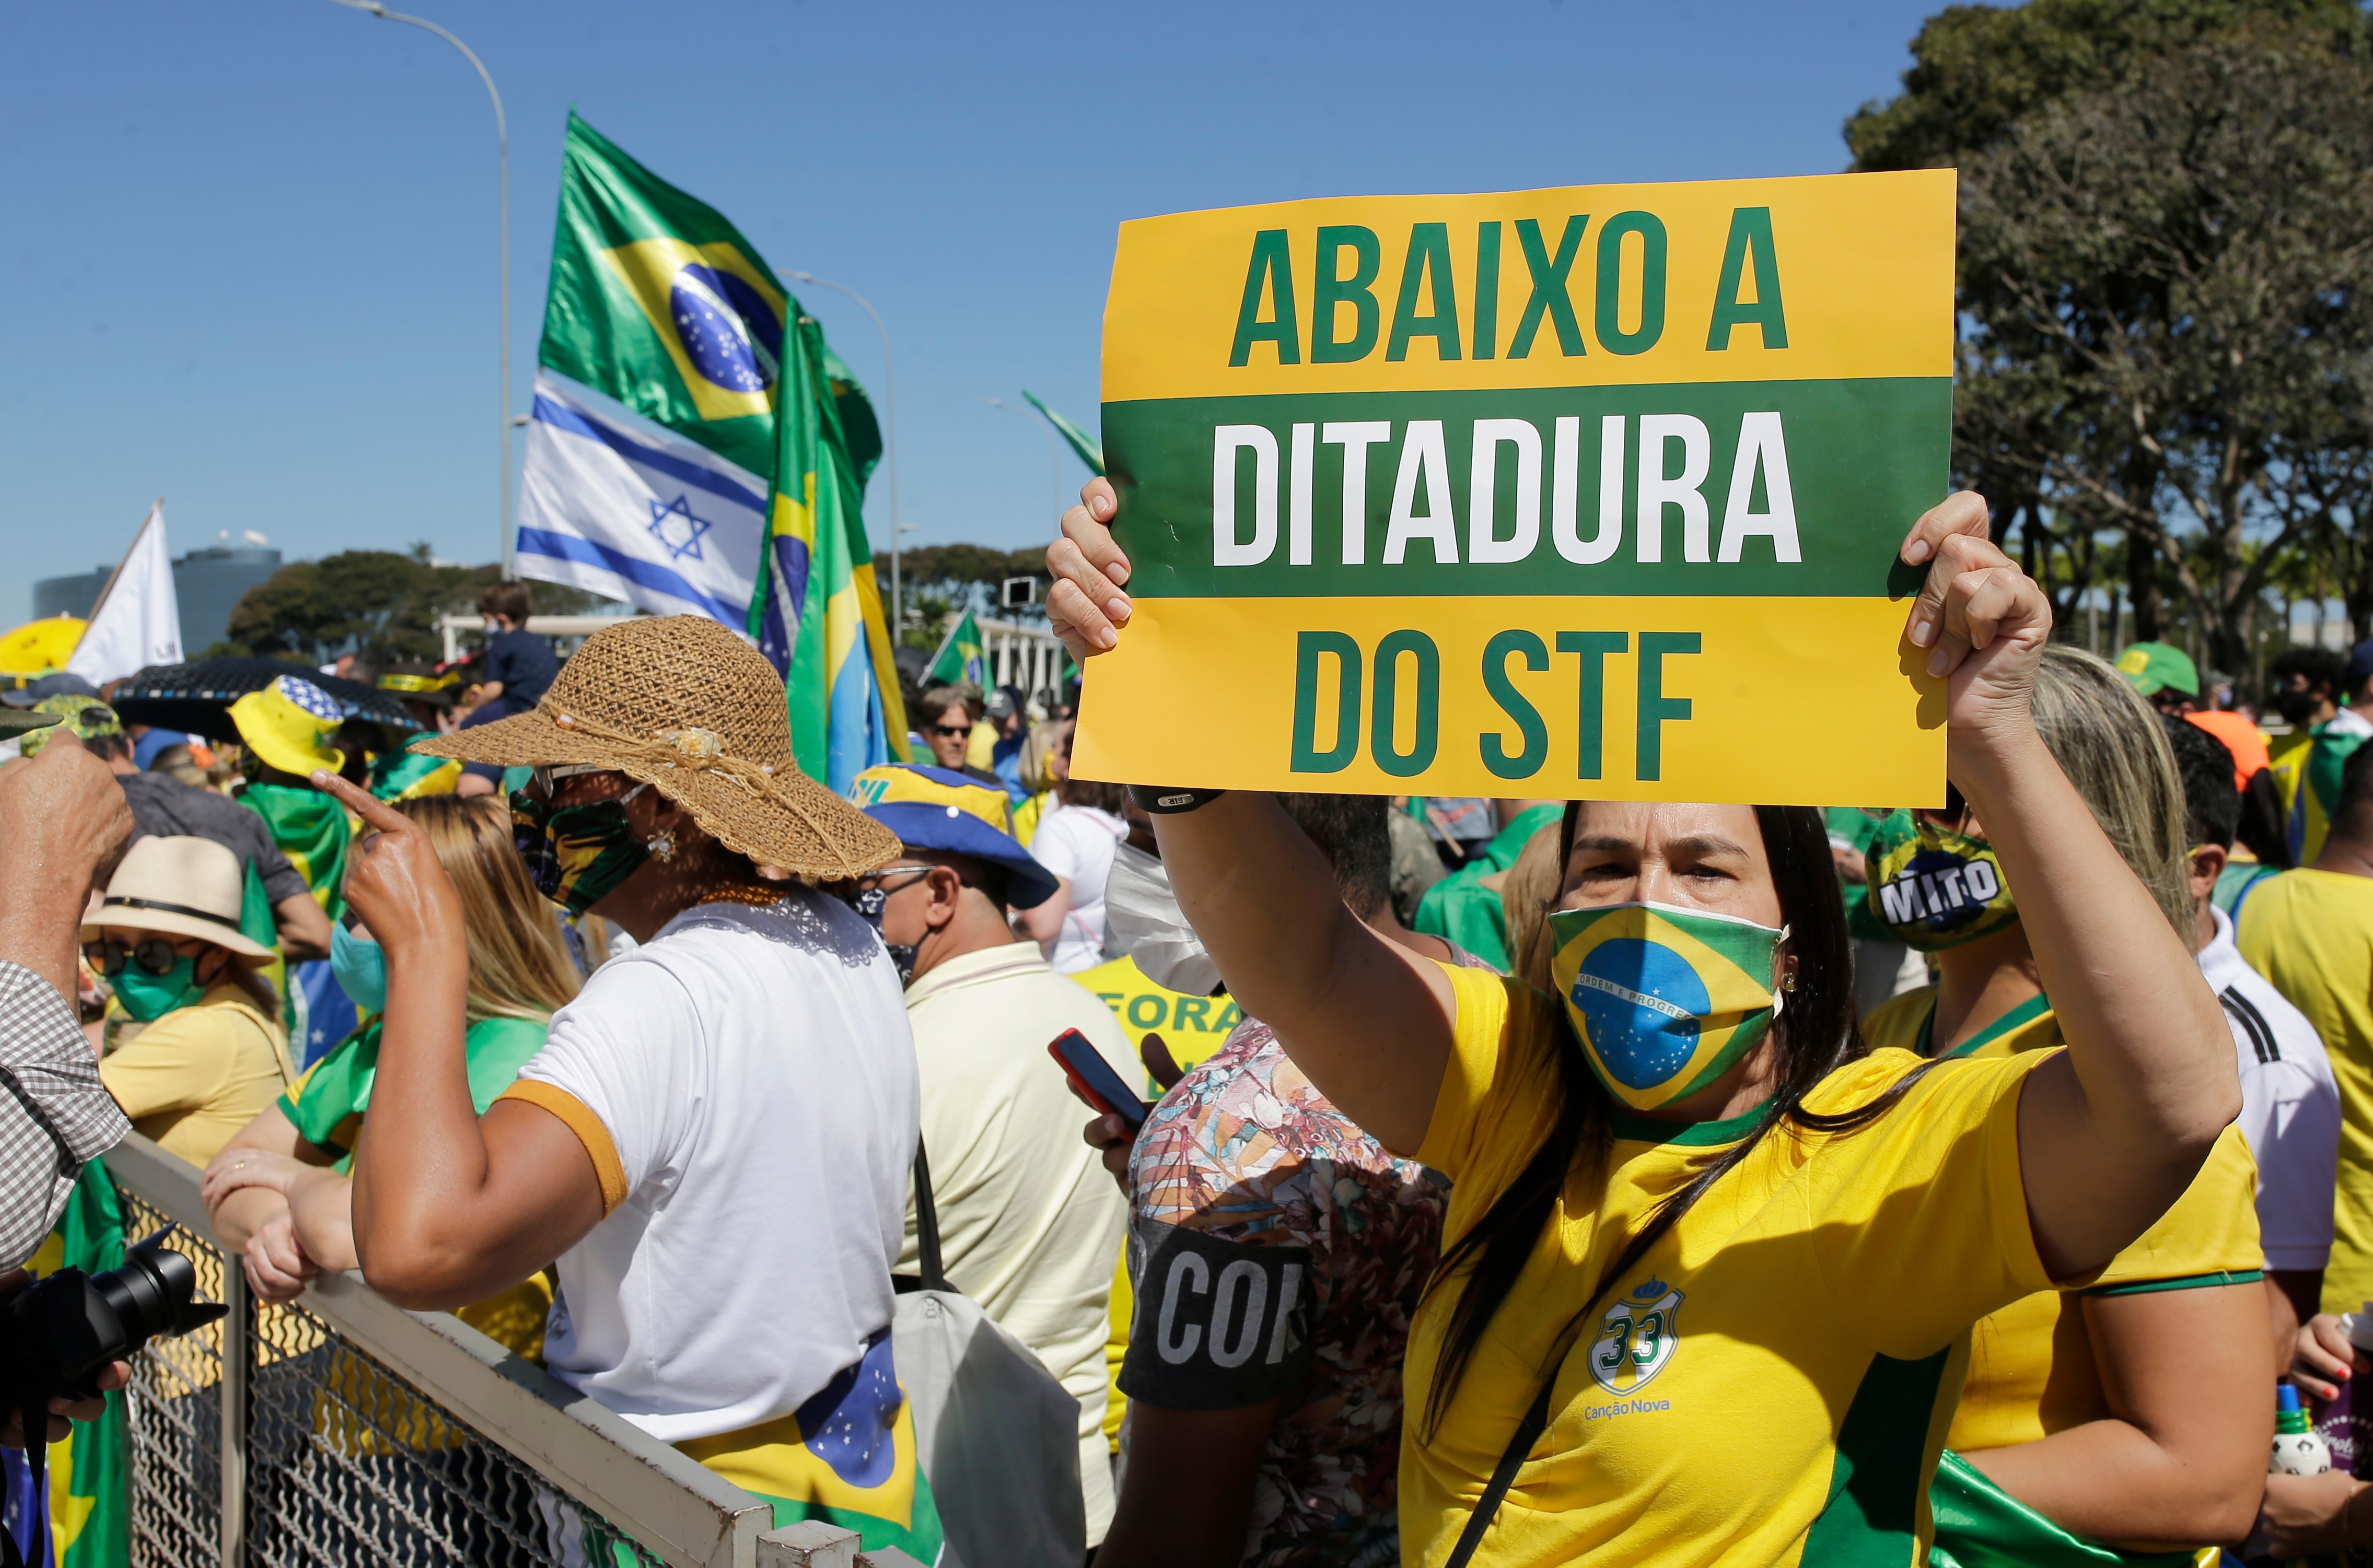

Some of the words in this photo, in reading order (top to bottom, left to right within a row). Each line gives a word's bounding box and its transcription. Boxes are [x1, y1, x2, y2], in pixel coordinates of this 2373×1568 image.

[1229, 211, 1667, 367] ABAIXO
[1706, 206, 1788, 351] A
[1213, 412, 1802, 566] DITADURA
[1290, 629, 1439, 777] DO
[1480, 629, 1702, 781] STF
[1879, 860, 1998, 924] MITO
[1579, 975, 1613, 992] ORDEM
[1618, 988, 1624, 997] E
[1599, 1309, 1666, 1370] 33
[1585, 1401, 1629, 1420] Canção
[1631, 1399, 1670, 1413] Nova
